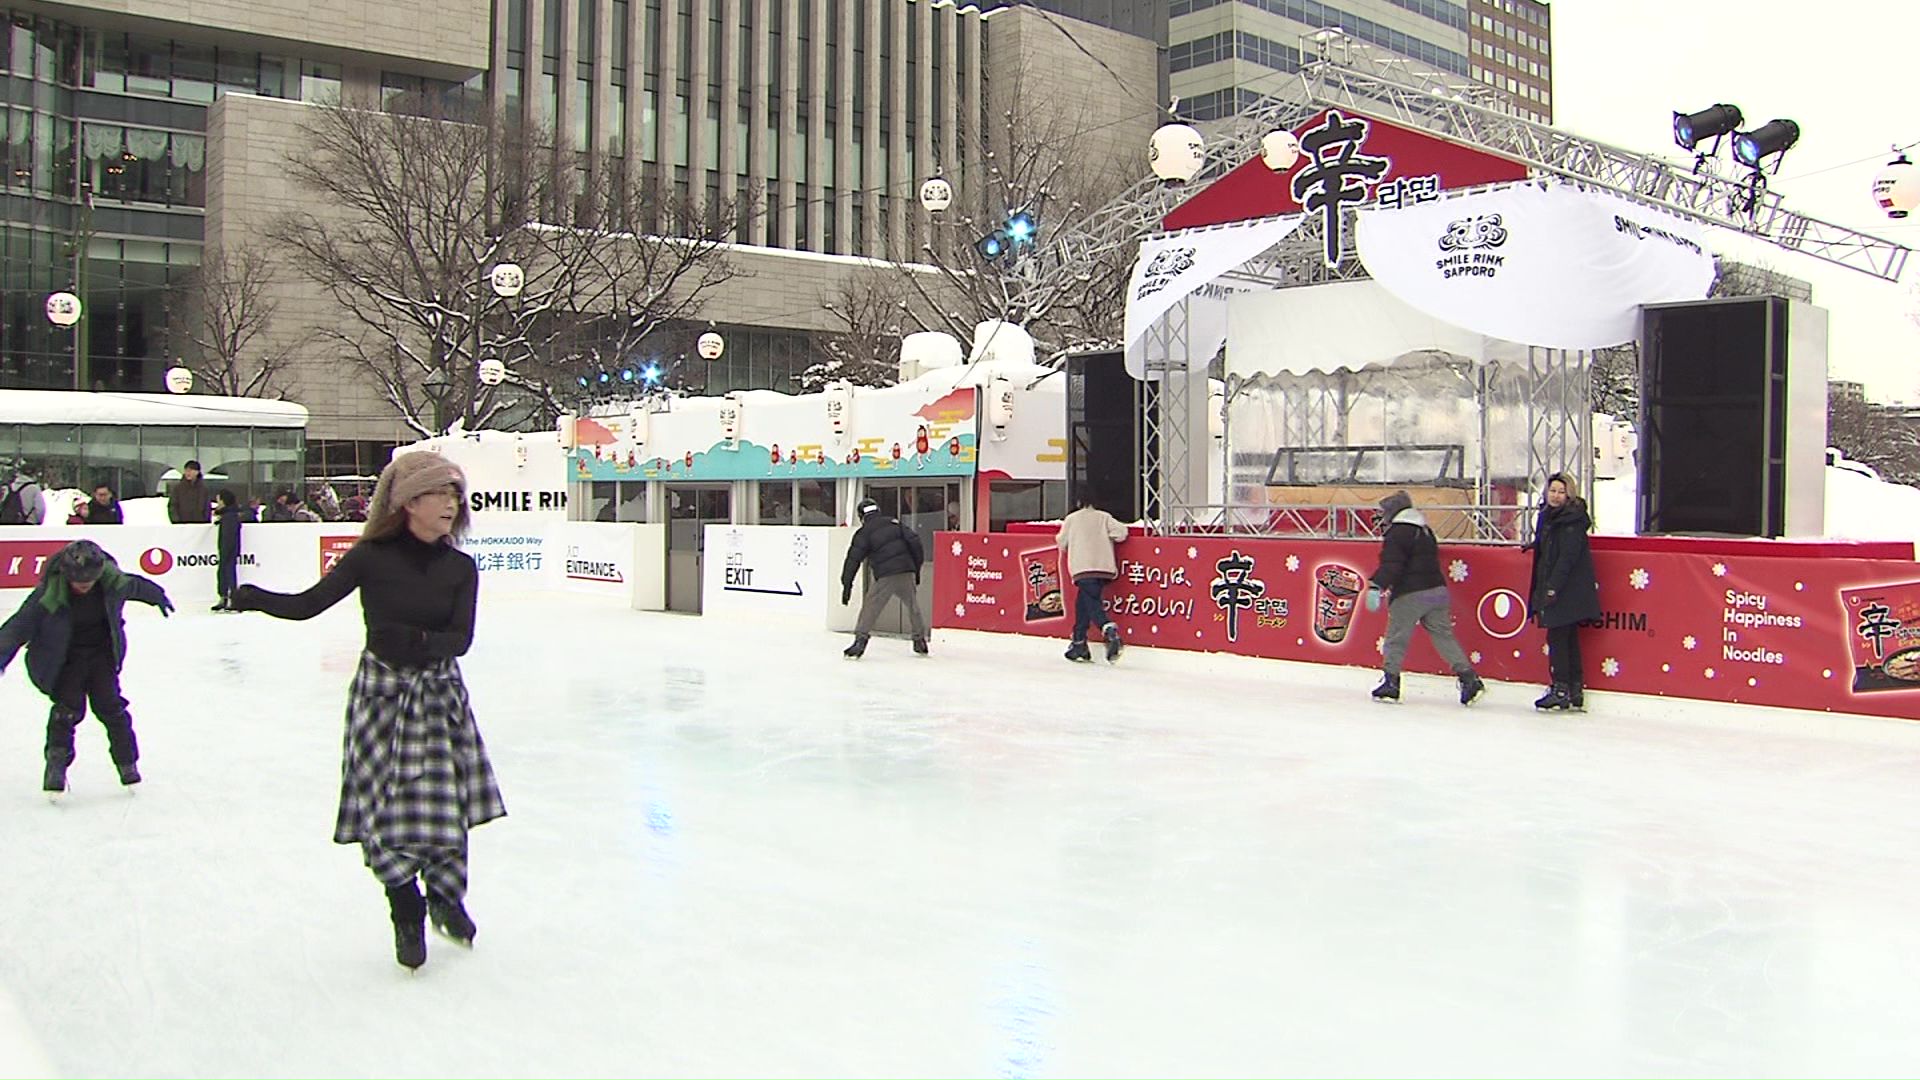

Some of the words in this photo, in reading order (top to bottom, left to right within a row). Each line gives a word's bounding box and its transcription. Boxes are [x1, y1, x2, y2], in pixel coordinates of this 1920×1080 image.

[1377, 175, 1440, 209] 라면
[1436, 254, 1469, 269] SMILE
[1472, 253, 1504, 267] RINK
[1443, 266, 1496, 278] SAPPORO
[470, 491, 533, 512] SMILE
[480, 536, 524, 545] HOKKAIDO
[526, 536, 543, 546] Way
[177, 553, 255, 567] NONGIM
[967, 555, 988, 569] Spicy
[566, 560, 616, 578] ENTRANCE
[725, 567, 754, 586] EXIT
[967, 567, 1003, 581] Happiness
[966, 592, 996, 605] Noodles
[1725, 589, 1766, 610] Spicy
[1254, 598, 1289, 617] 라면
[1257, 615, 1287, 628] ラーメン
[1723, 608, 1801, 628] Happiness
[1723, 627, 1737, 642] In
[1723, 645, 1784, 664] Noodles
